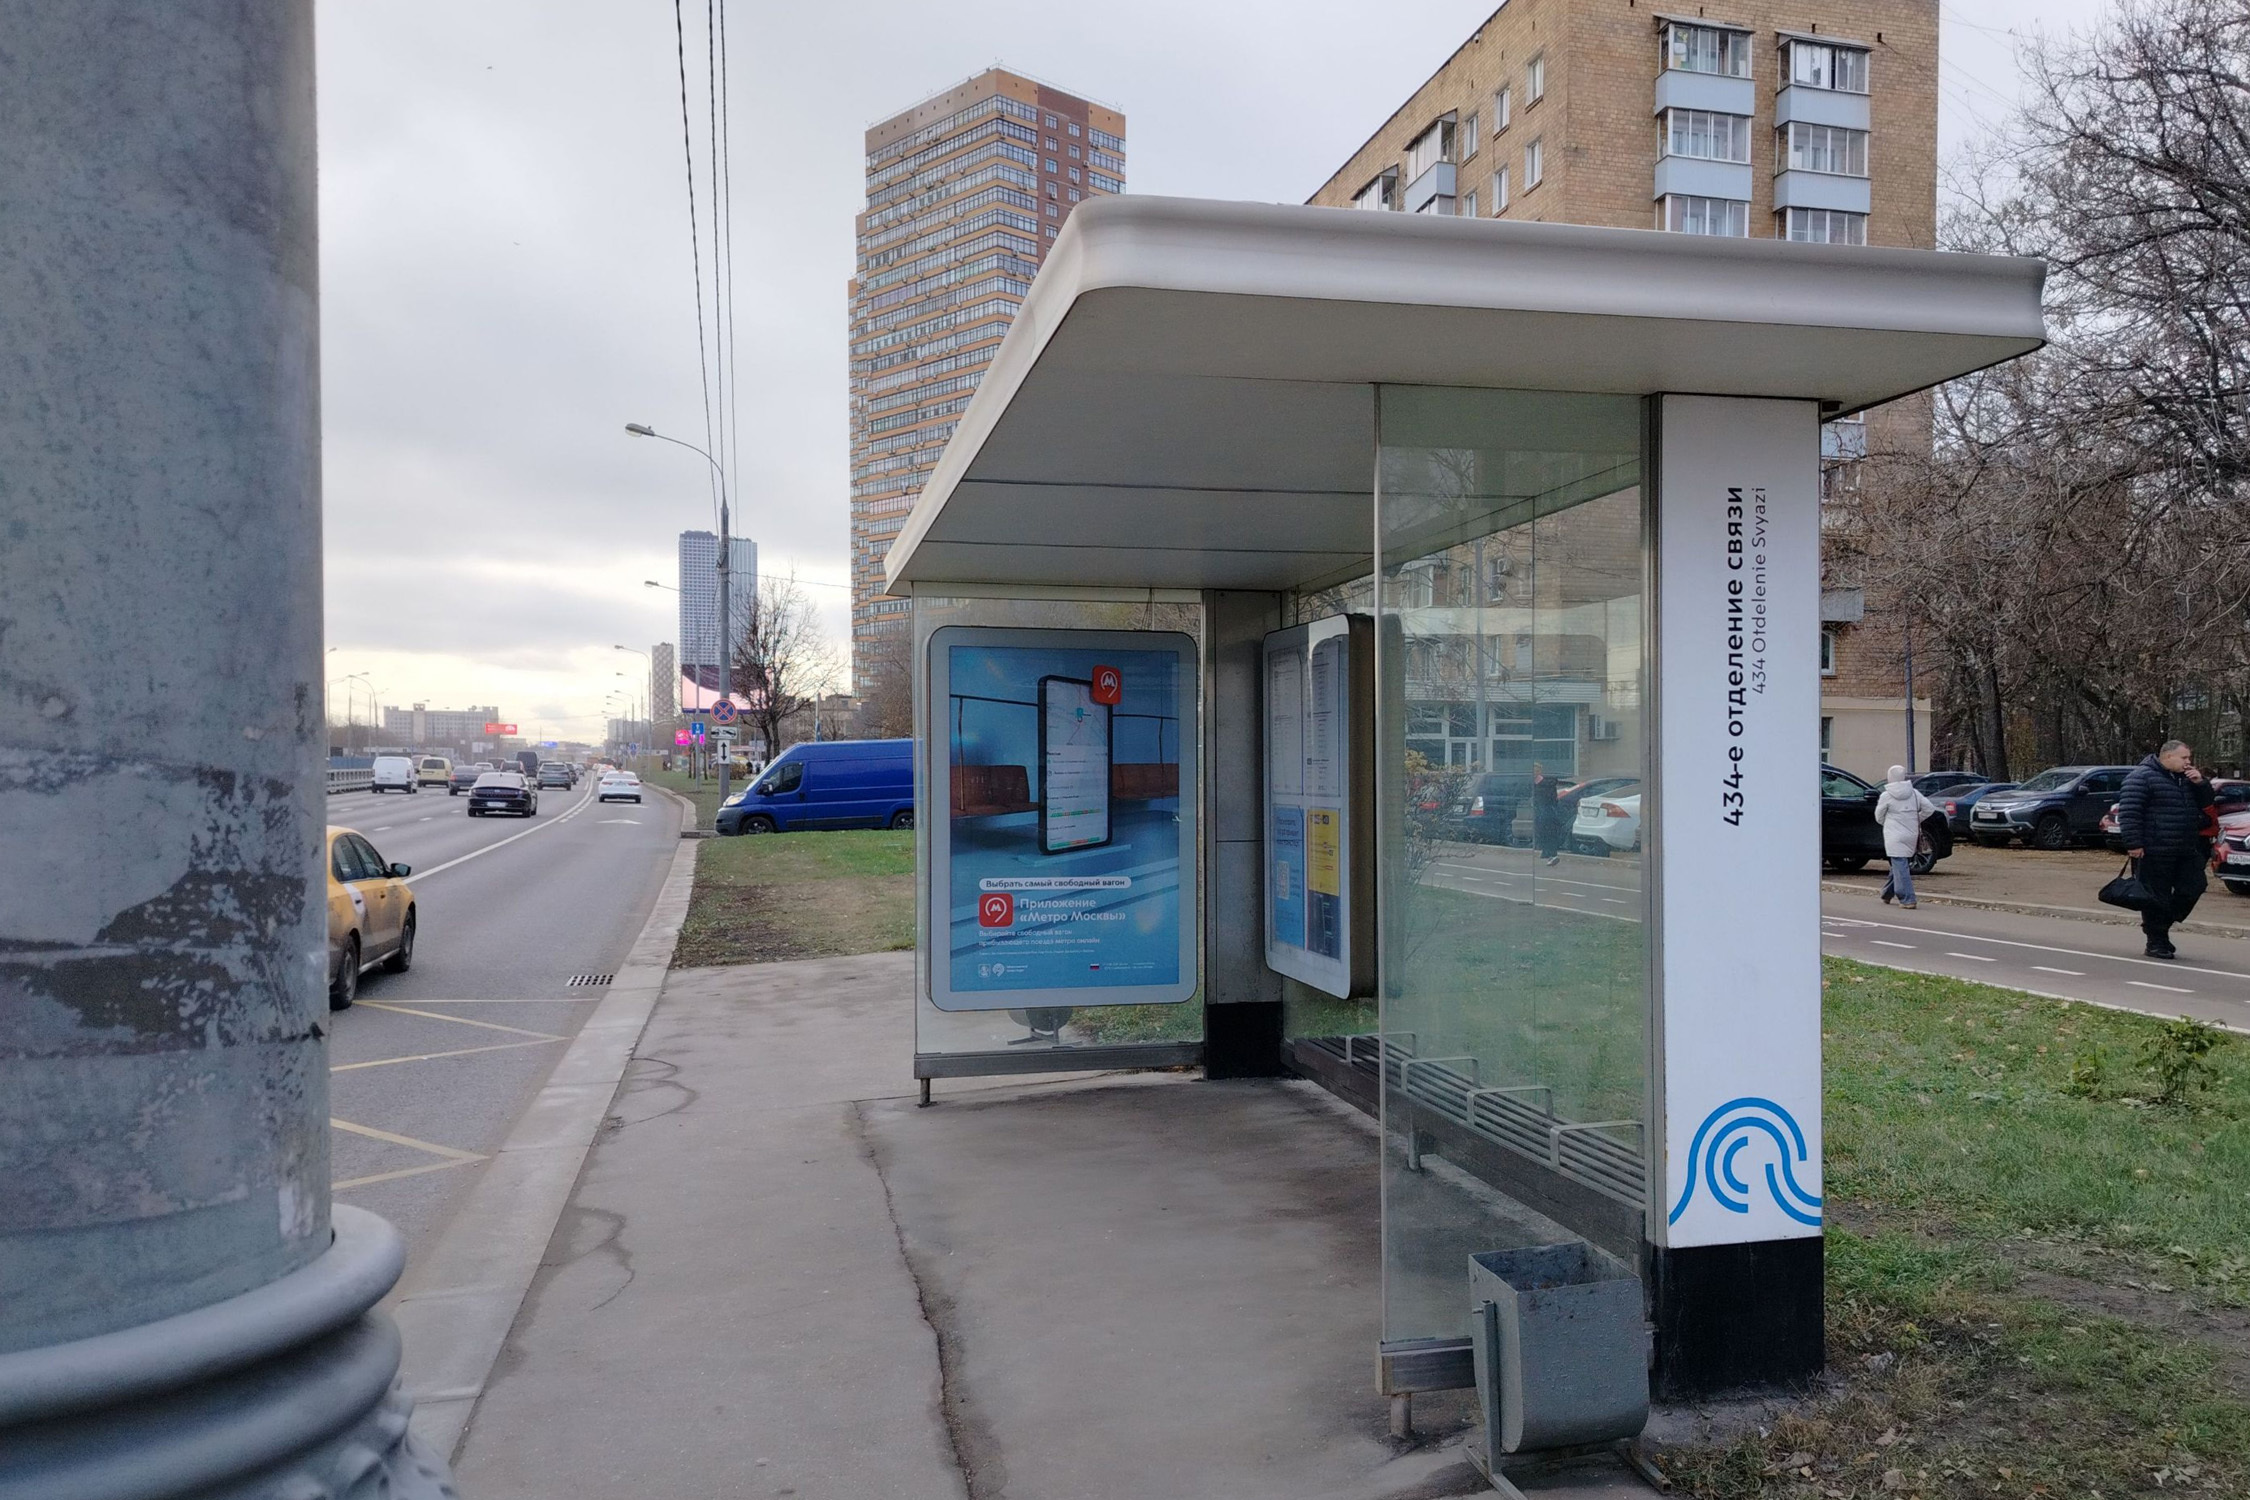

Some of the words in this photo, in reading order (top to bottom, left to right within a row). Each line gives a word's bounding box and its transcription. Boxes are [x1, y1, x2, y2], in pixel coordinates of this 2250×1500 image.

[1727, 487, 1743, 570] связи
[1751, 487, 1769, 547] Svyazi
[1751, 553, 1766, 652] Otdelenie
[1727, 579, 1746, 737] отделение
[1751, 657, 1767, 694] 434
[1722, 745, 1744, 827] 434-е
[985, 880, 1023, 888] Выбрать
[1054, 879, 1101, 887] свободный
[1020, 898, 1097, 911] Приложение
[1020, 911, 1068, 923] «Метро
[1070, 910, 1126, 921] Москвы»
